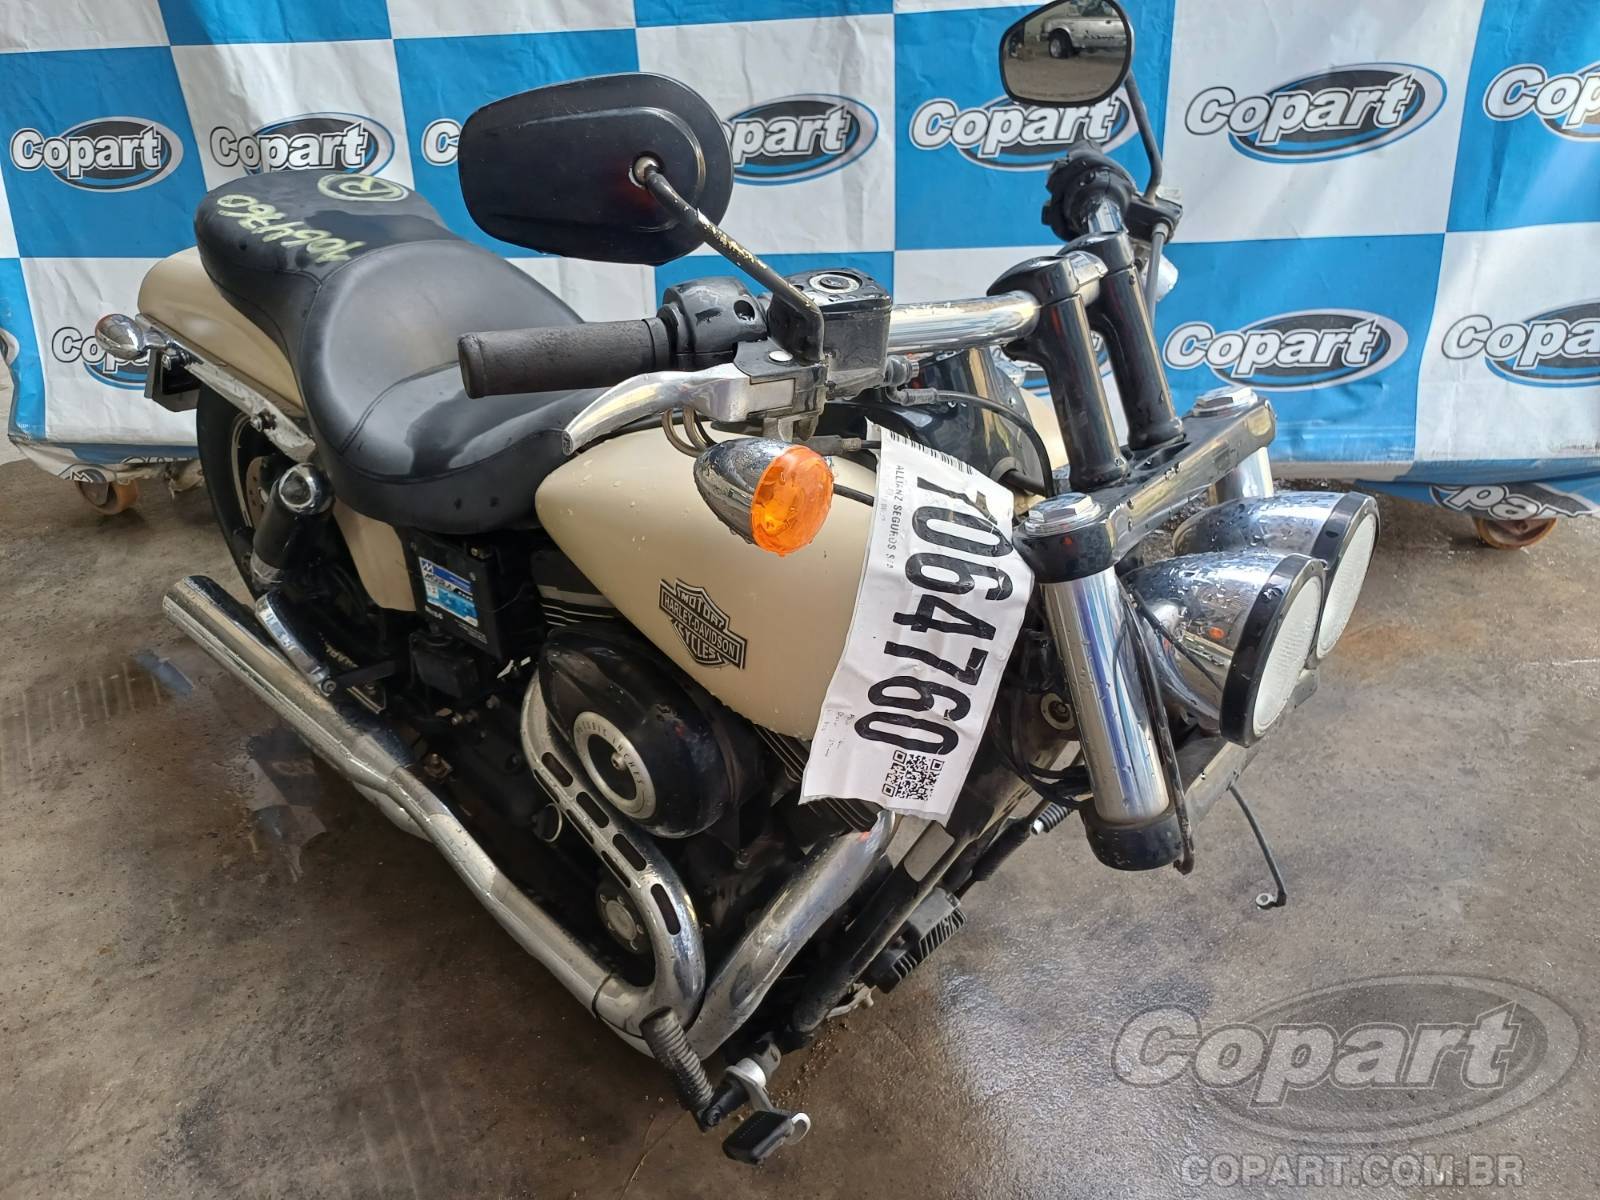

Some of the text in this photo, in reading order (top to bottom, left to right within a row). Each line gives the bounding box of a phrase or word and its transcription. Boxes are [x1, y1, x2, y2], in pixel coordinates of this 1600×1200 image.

[727, 104, 852, 168] part
[909, 95, 1120, 158] Copart
[1184, 72, 1417, 147] Copart
[10, 124, 163, 180] Copart
[210, 122, 369, 172] Copart
[52, 326, 151, 373] Co
[1162, 316, 1382, 378] Copart
[664, 594, 736, 658] HARLEY-DAVIDSON
[681, 592, 720, 628] MOTOR
[854, 476, 1014, 756] 7064760
